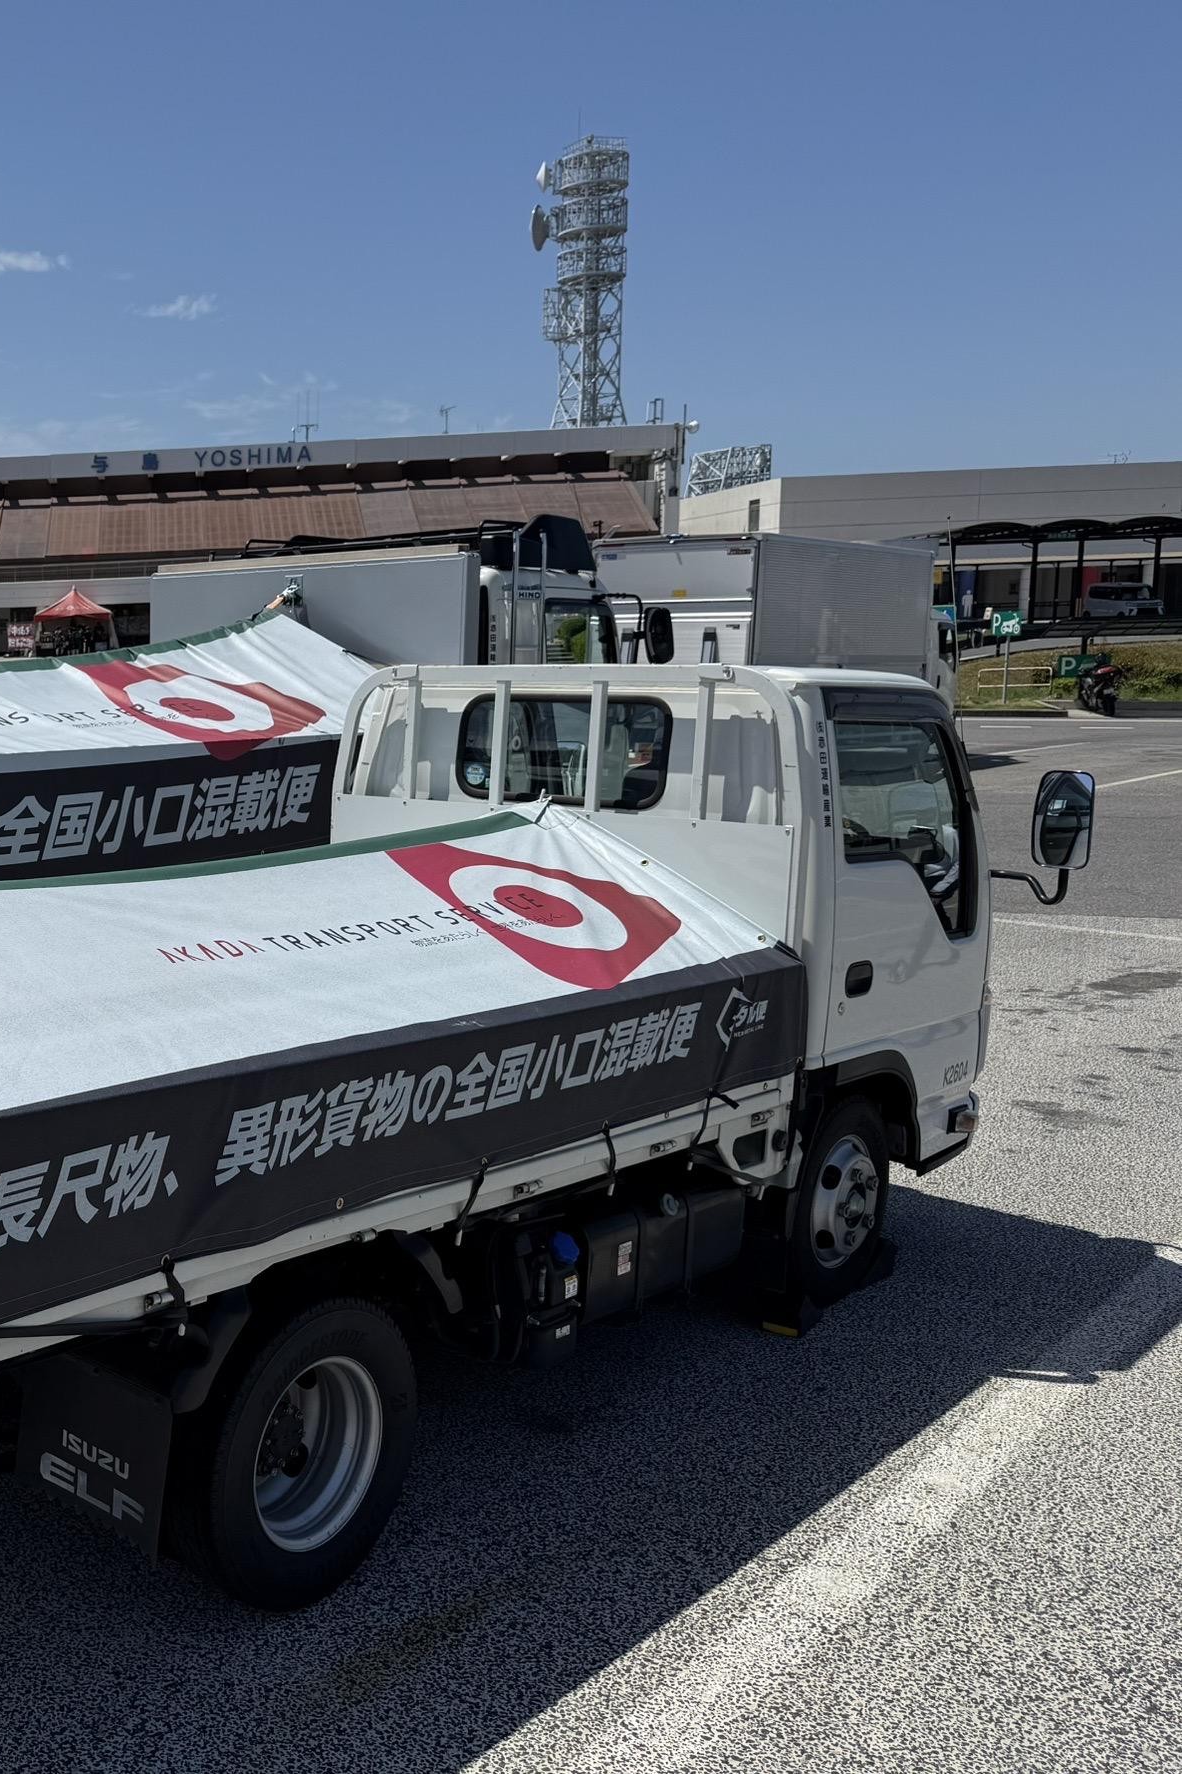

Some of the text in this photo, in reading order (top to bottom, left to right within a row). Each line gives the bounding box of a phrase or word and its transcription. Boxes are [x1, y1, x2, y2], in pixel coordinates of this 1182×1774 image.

[195, 445, 312, 467] YOSHIMA
[992, 613, 1002, 635] P
[1060, 656, 1077, 676] P
[157, 893, 544, 963] AKADA TRANSPORT SERVICE
[942, 1060, 969, 1088] K2604
[215, 1002, 702, 1186] 異形貨物の全国小口混載便
[62, 1429, 129, 1480] ISUZU
[40, 1452, 145, 1524] ELF
